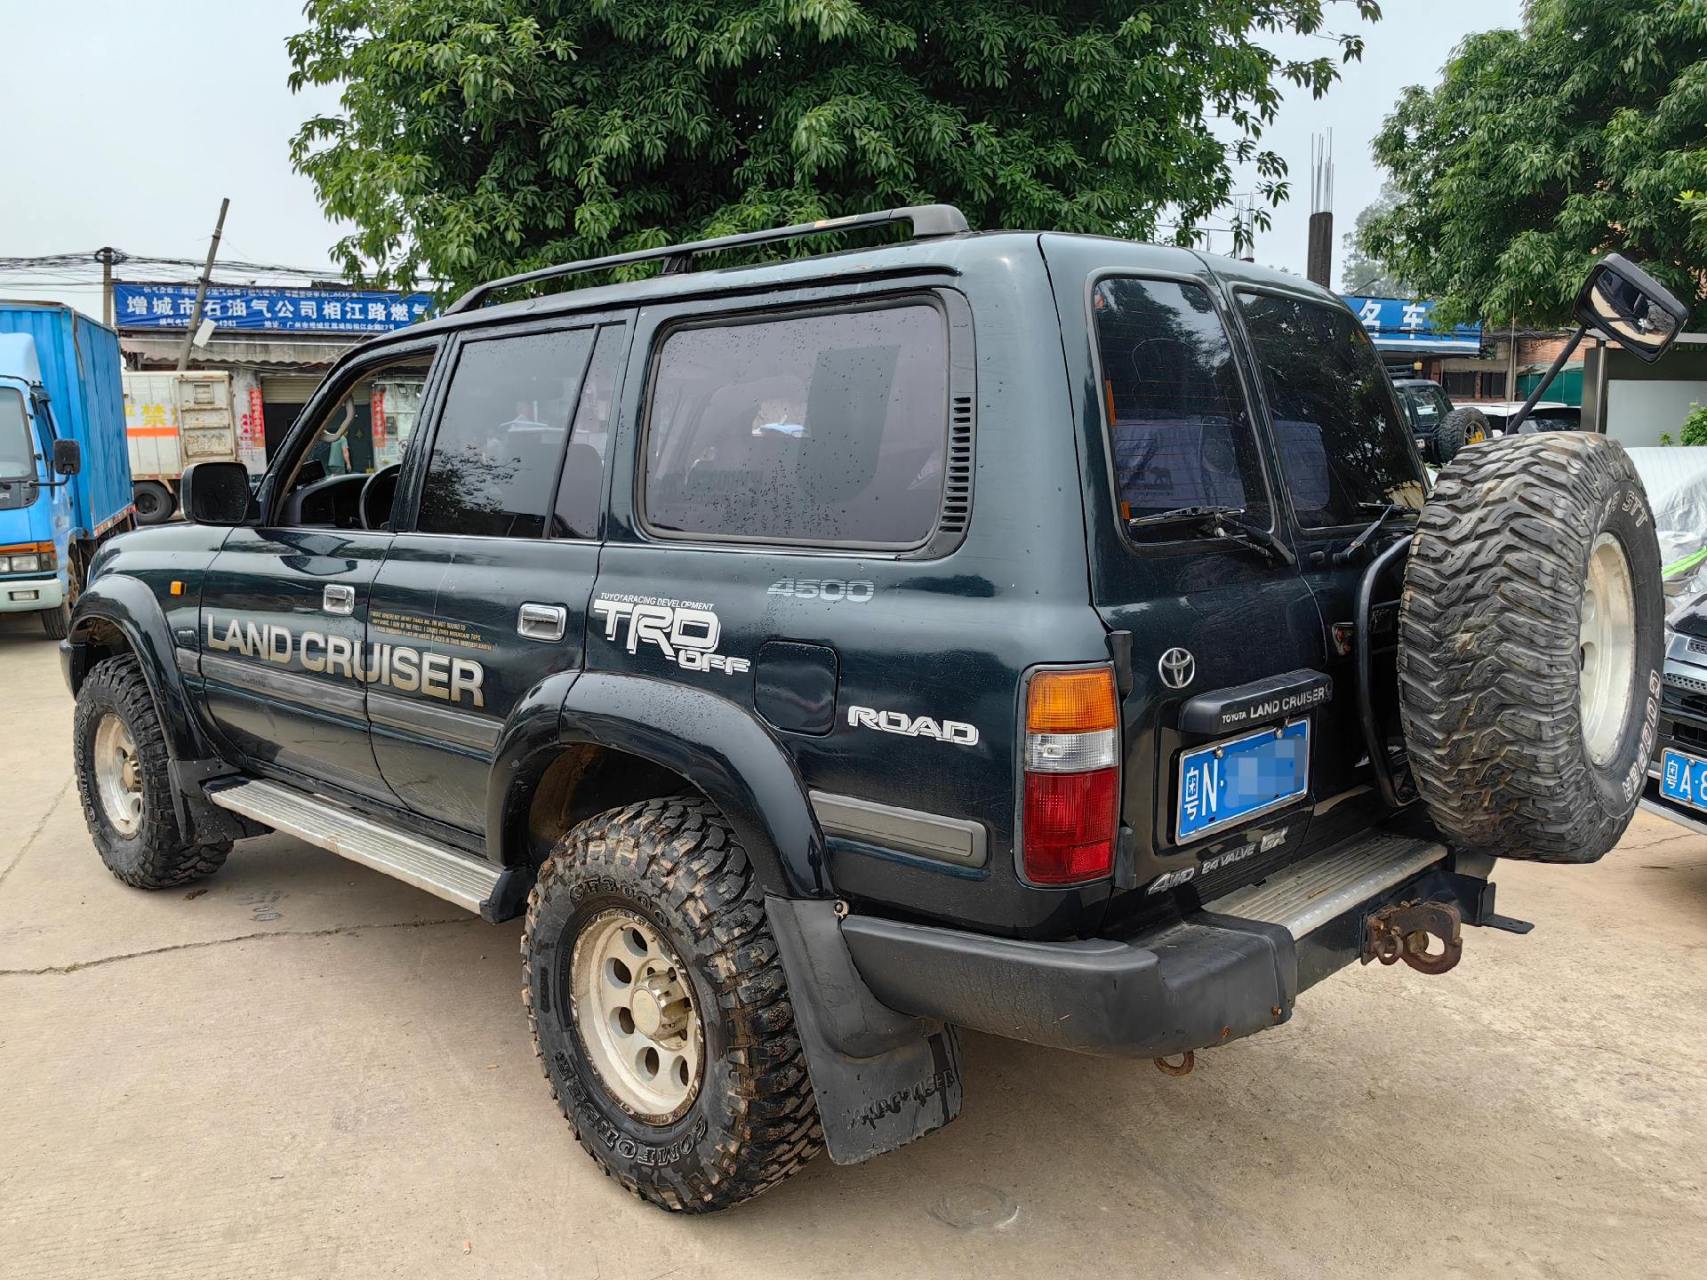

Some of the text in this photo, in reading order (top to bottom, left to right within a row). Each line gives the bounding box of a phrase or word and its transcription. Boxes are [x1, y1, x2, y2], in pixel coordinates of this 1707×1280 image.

[1621, 490, 1649, 528] STT
[656, 597, 715, 611] DEVELOPMENT
[766, 577, 875, 603] 4500
[594, 599, 721, 660] TRD
[207, 613, 293, 665] LAND
[300, 631, 485, 708] CRUISER
[678, 649, 752, 676] OFF
[1222, 686, 1325, 724] TOYOTA LAND CRUISER
[847, 704, 980, 747] ROAD
[1622, 669, 1661, 802] COOPER
